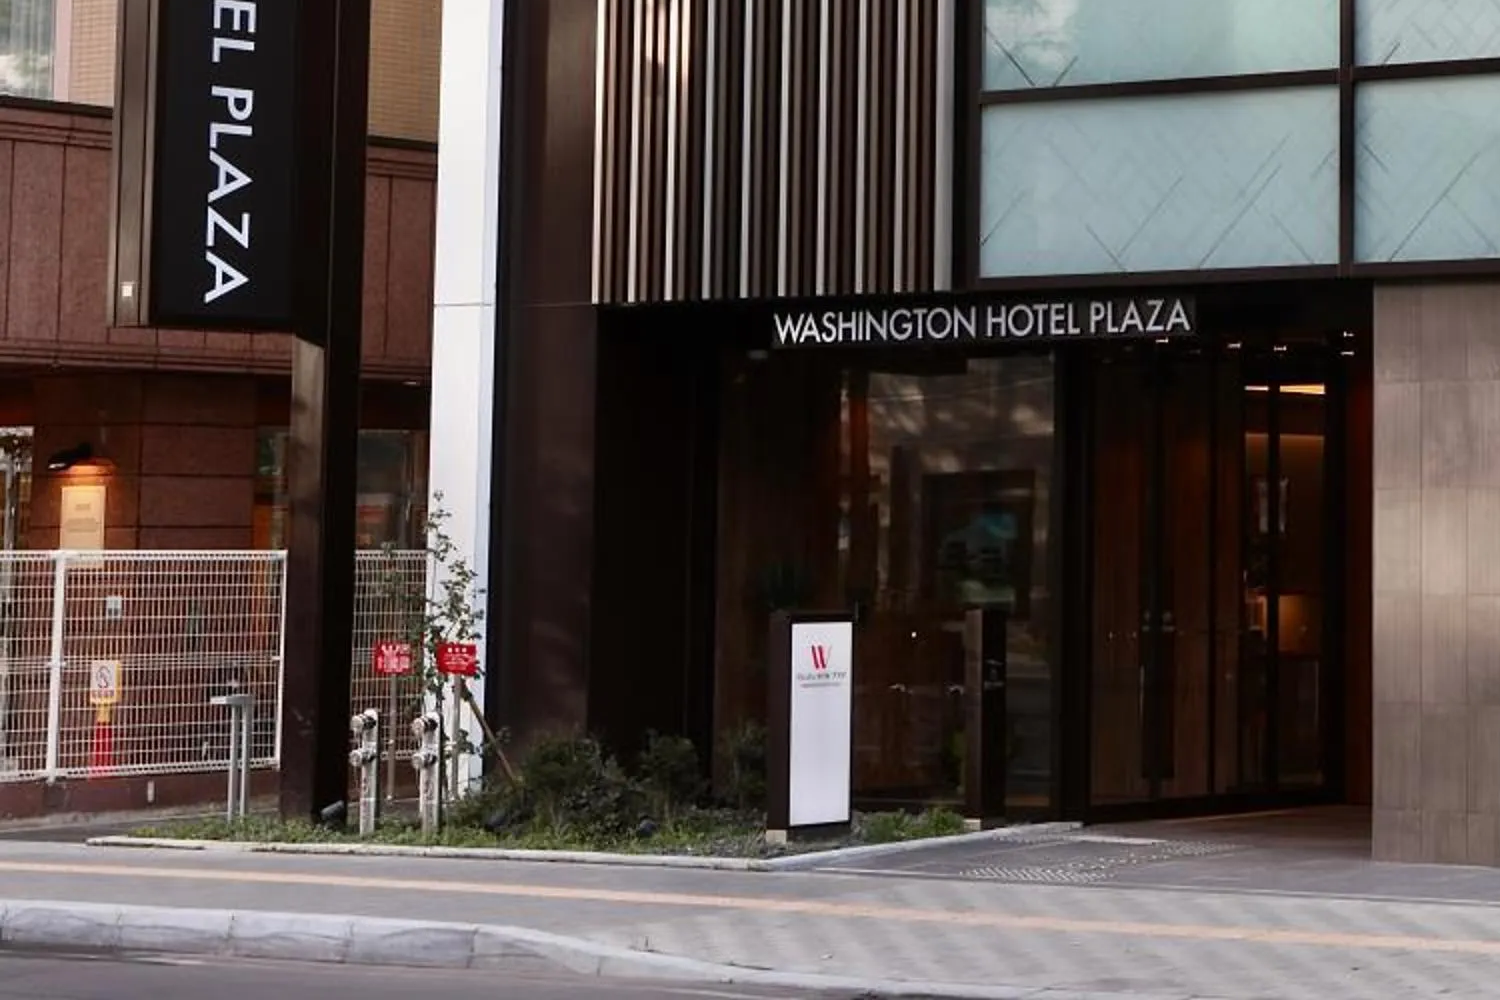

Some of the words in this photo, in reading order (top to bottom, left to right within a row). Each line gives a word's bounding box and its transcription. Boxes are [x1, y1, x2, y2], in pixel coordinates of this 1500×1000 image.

[203, 85, 254, 304] PLAZA
[773, 307, 977, 344] WASHINGTON
[986, 302, 1080, 337] HOTEL
[1089, 298, 1192, 334] PLAZA
